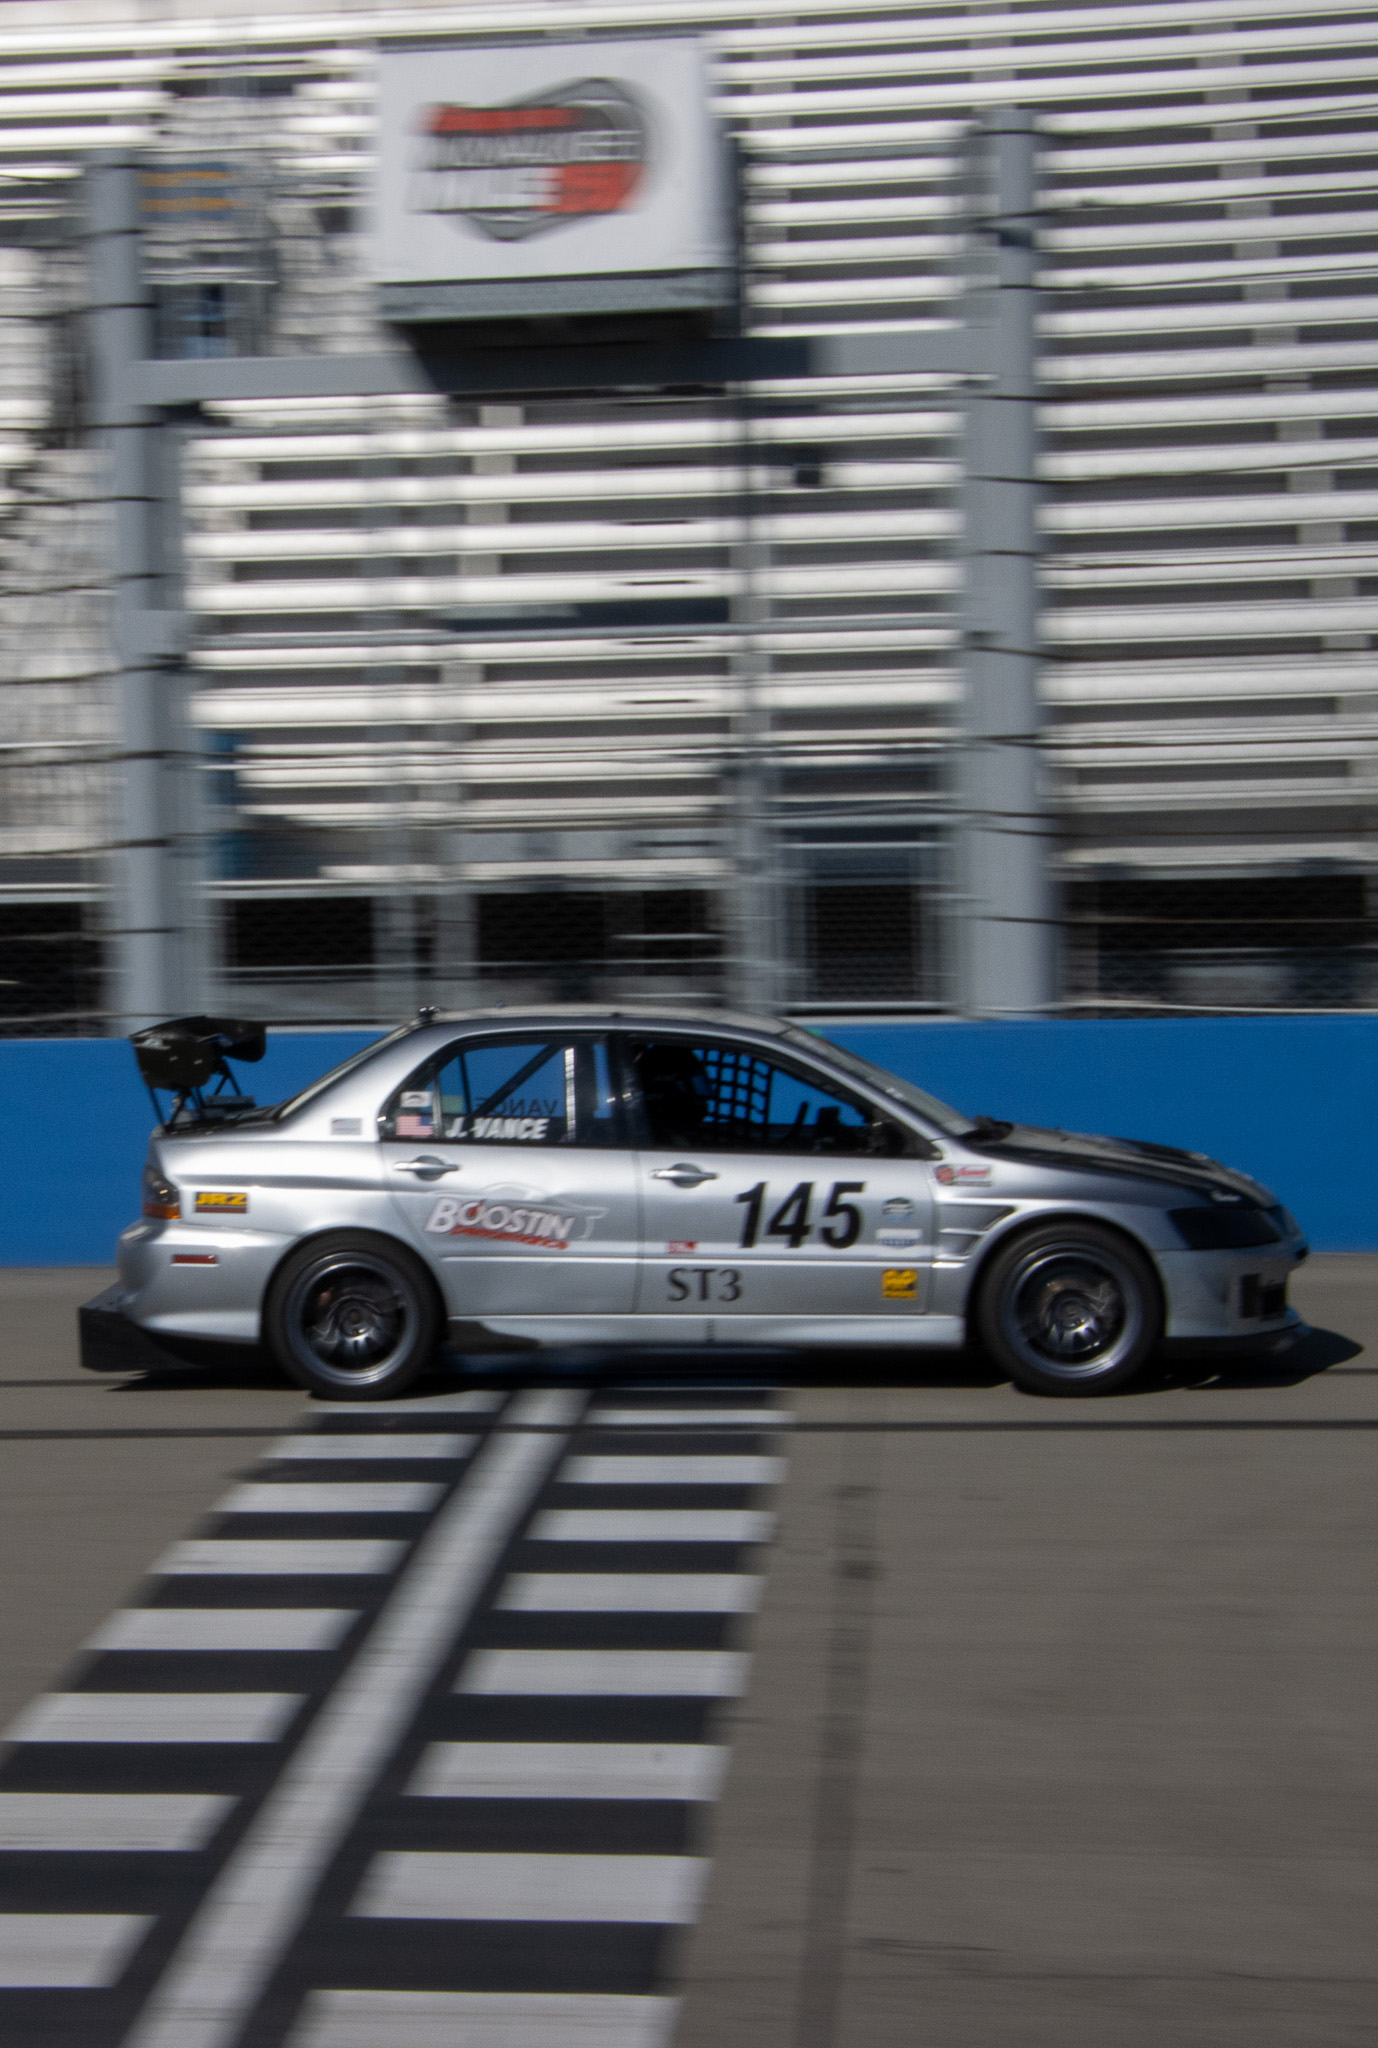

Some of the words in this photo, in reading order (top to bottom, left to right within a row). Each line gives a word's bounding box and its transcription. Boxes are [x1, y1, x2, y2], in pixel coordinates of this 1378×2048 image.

[445, 1116, 468, 1138] J.
[472, 1117, 550, 1139] VANCE
[195, 1192, 248, 1205] JRZ
[735, 1182, 867, 1249] 145
[424, 1197, 575, 1240] BOOSTIN
[667, 1267, 743, 1301] ST3
